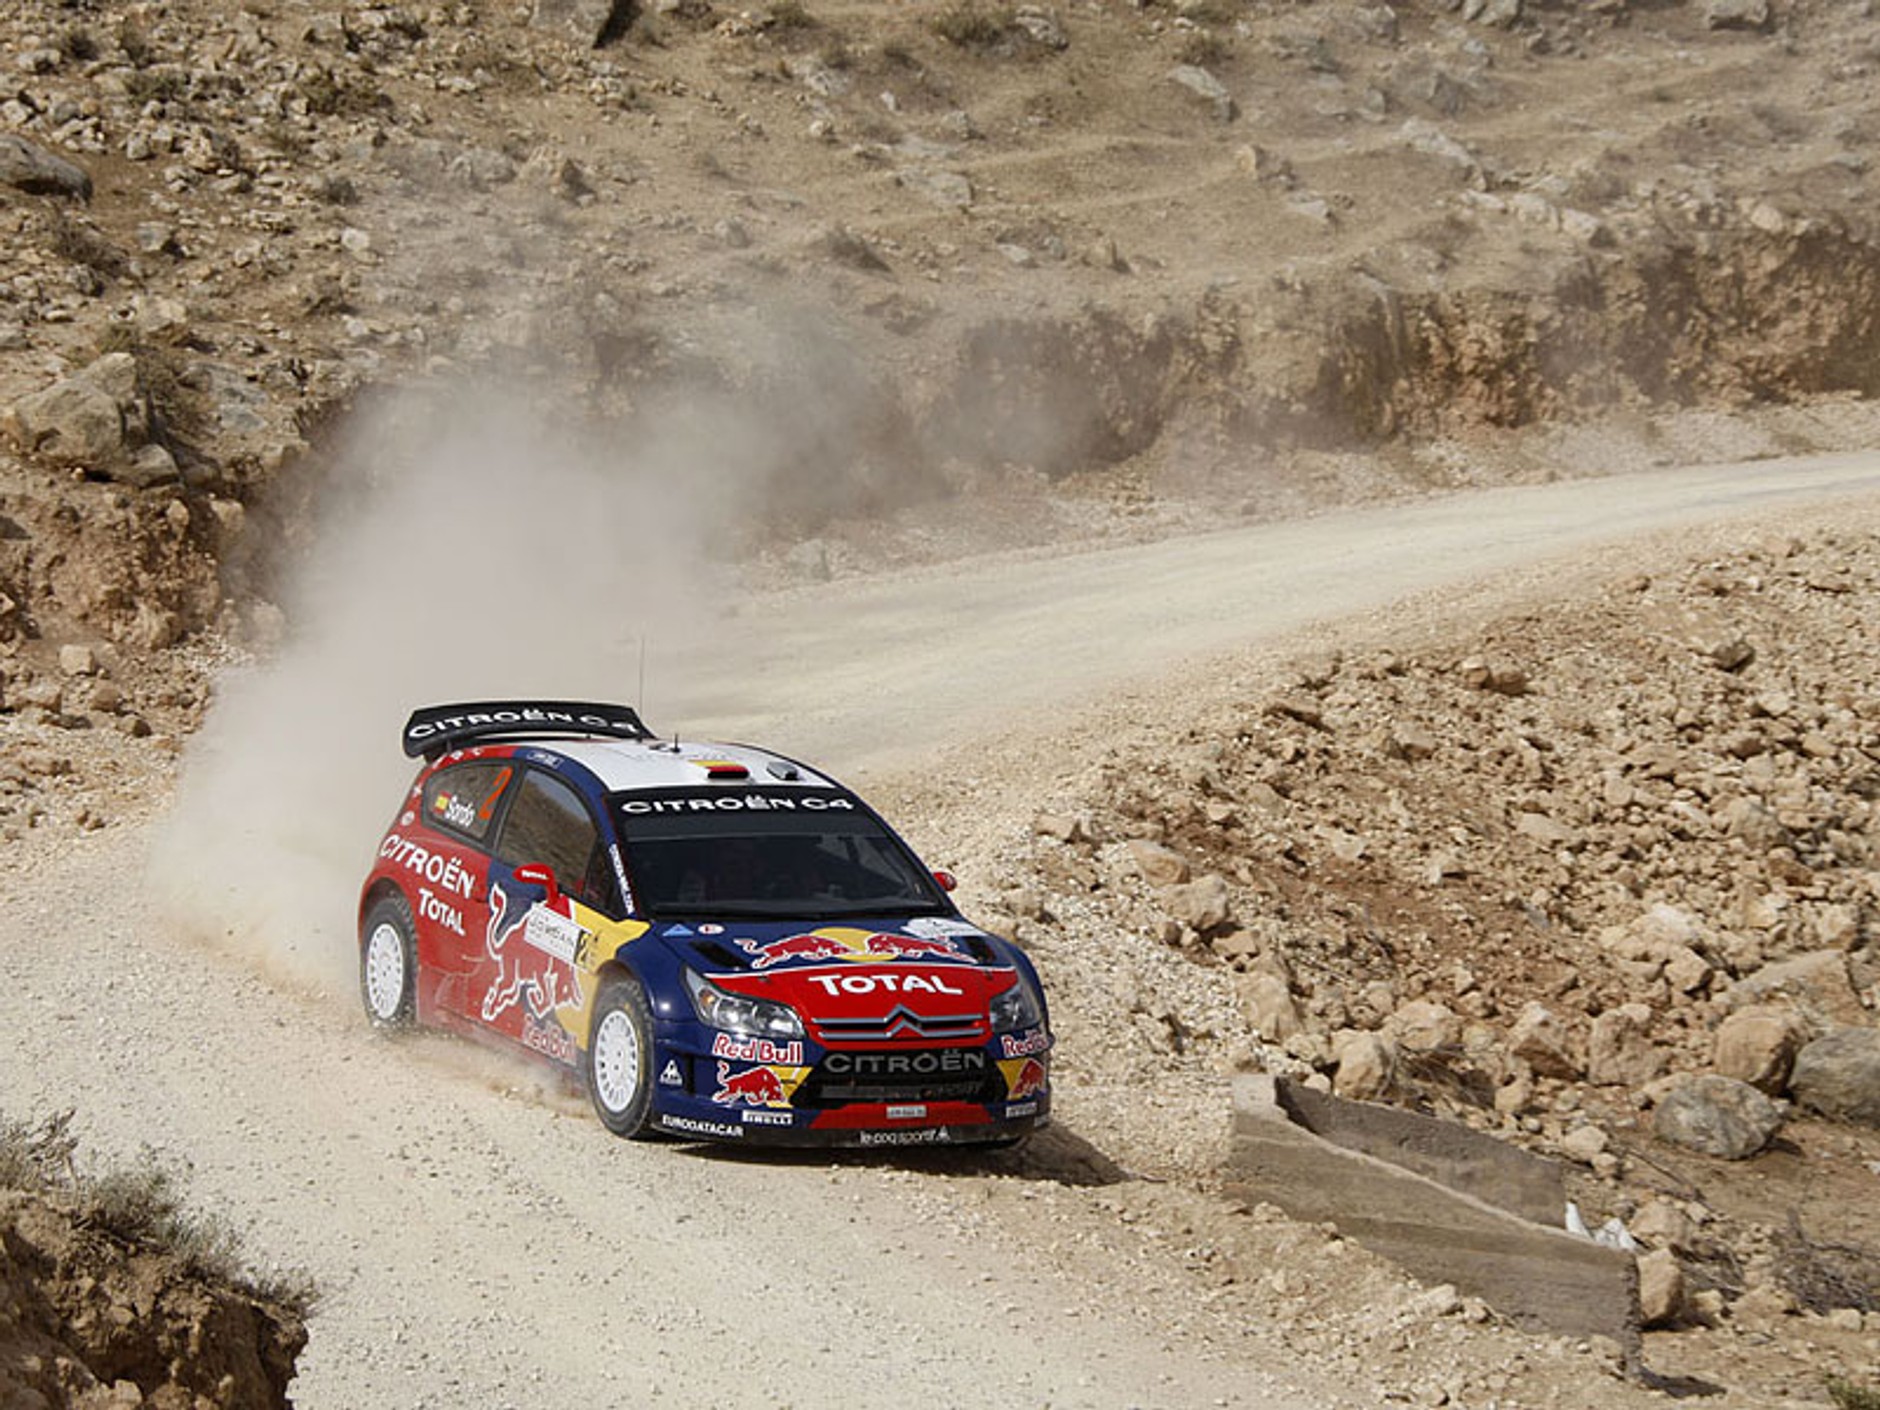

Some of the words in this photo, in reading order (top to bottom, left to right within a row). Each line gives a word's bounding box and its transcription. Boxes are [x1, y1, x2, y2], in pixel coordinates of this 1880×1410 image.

[409, 709, 573, 738] CITROËN
[580, 714, 640, 733] C4
[477, 766, 513, 821] 2
[621, 794, 796, 813] CITROËN
[801, 798, 854, 811] C4
[379, 834, 476, 899] CITROËN
[808, 973, 963, 996] TOTAL
[712, 1032, 757, 1059] Red
[758, 1041, 803, 1064] Bull
[824, 1050, 985, 1074] CITROËN
[874, 1132, 897, 1145] coq
